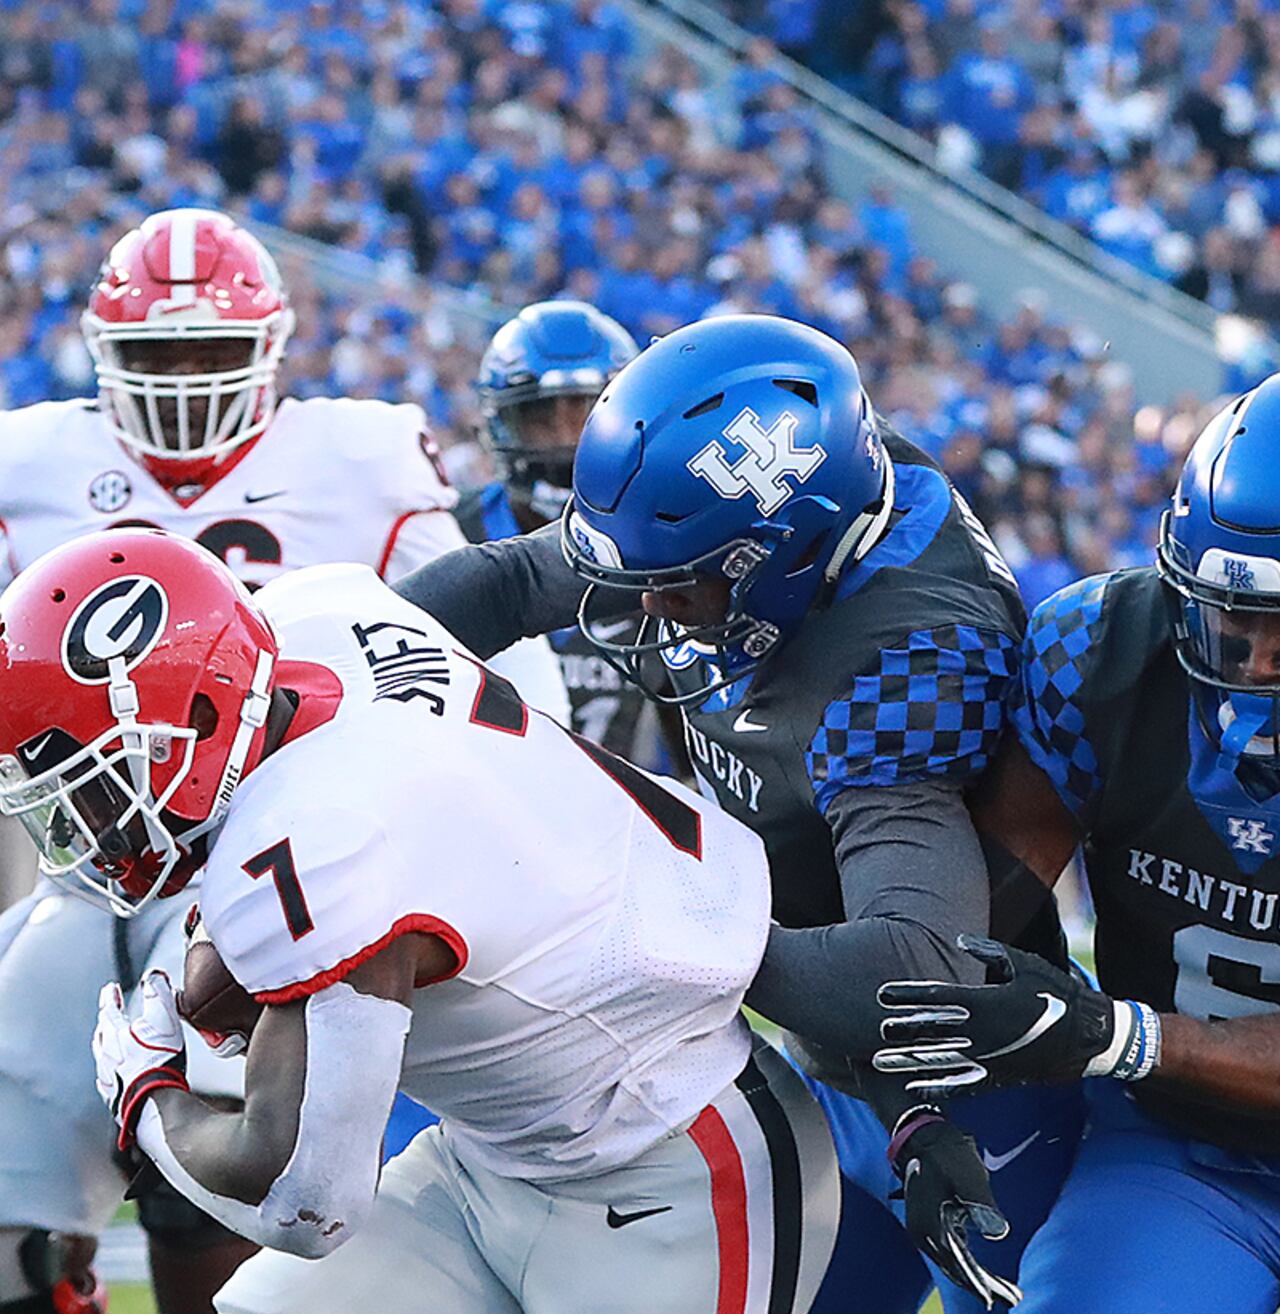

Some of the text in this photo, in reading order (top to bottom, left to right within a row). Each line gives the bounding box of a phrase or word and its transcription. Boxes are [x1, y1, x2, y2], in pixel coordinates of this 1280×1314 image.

[686, 406, 828, 518] UK
[352, 622, 450, 716] SWIFT
[687, 722, 763, 812] UCKY
[240, 836, 315, 942] 7
